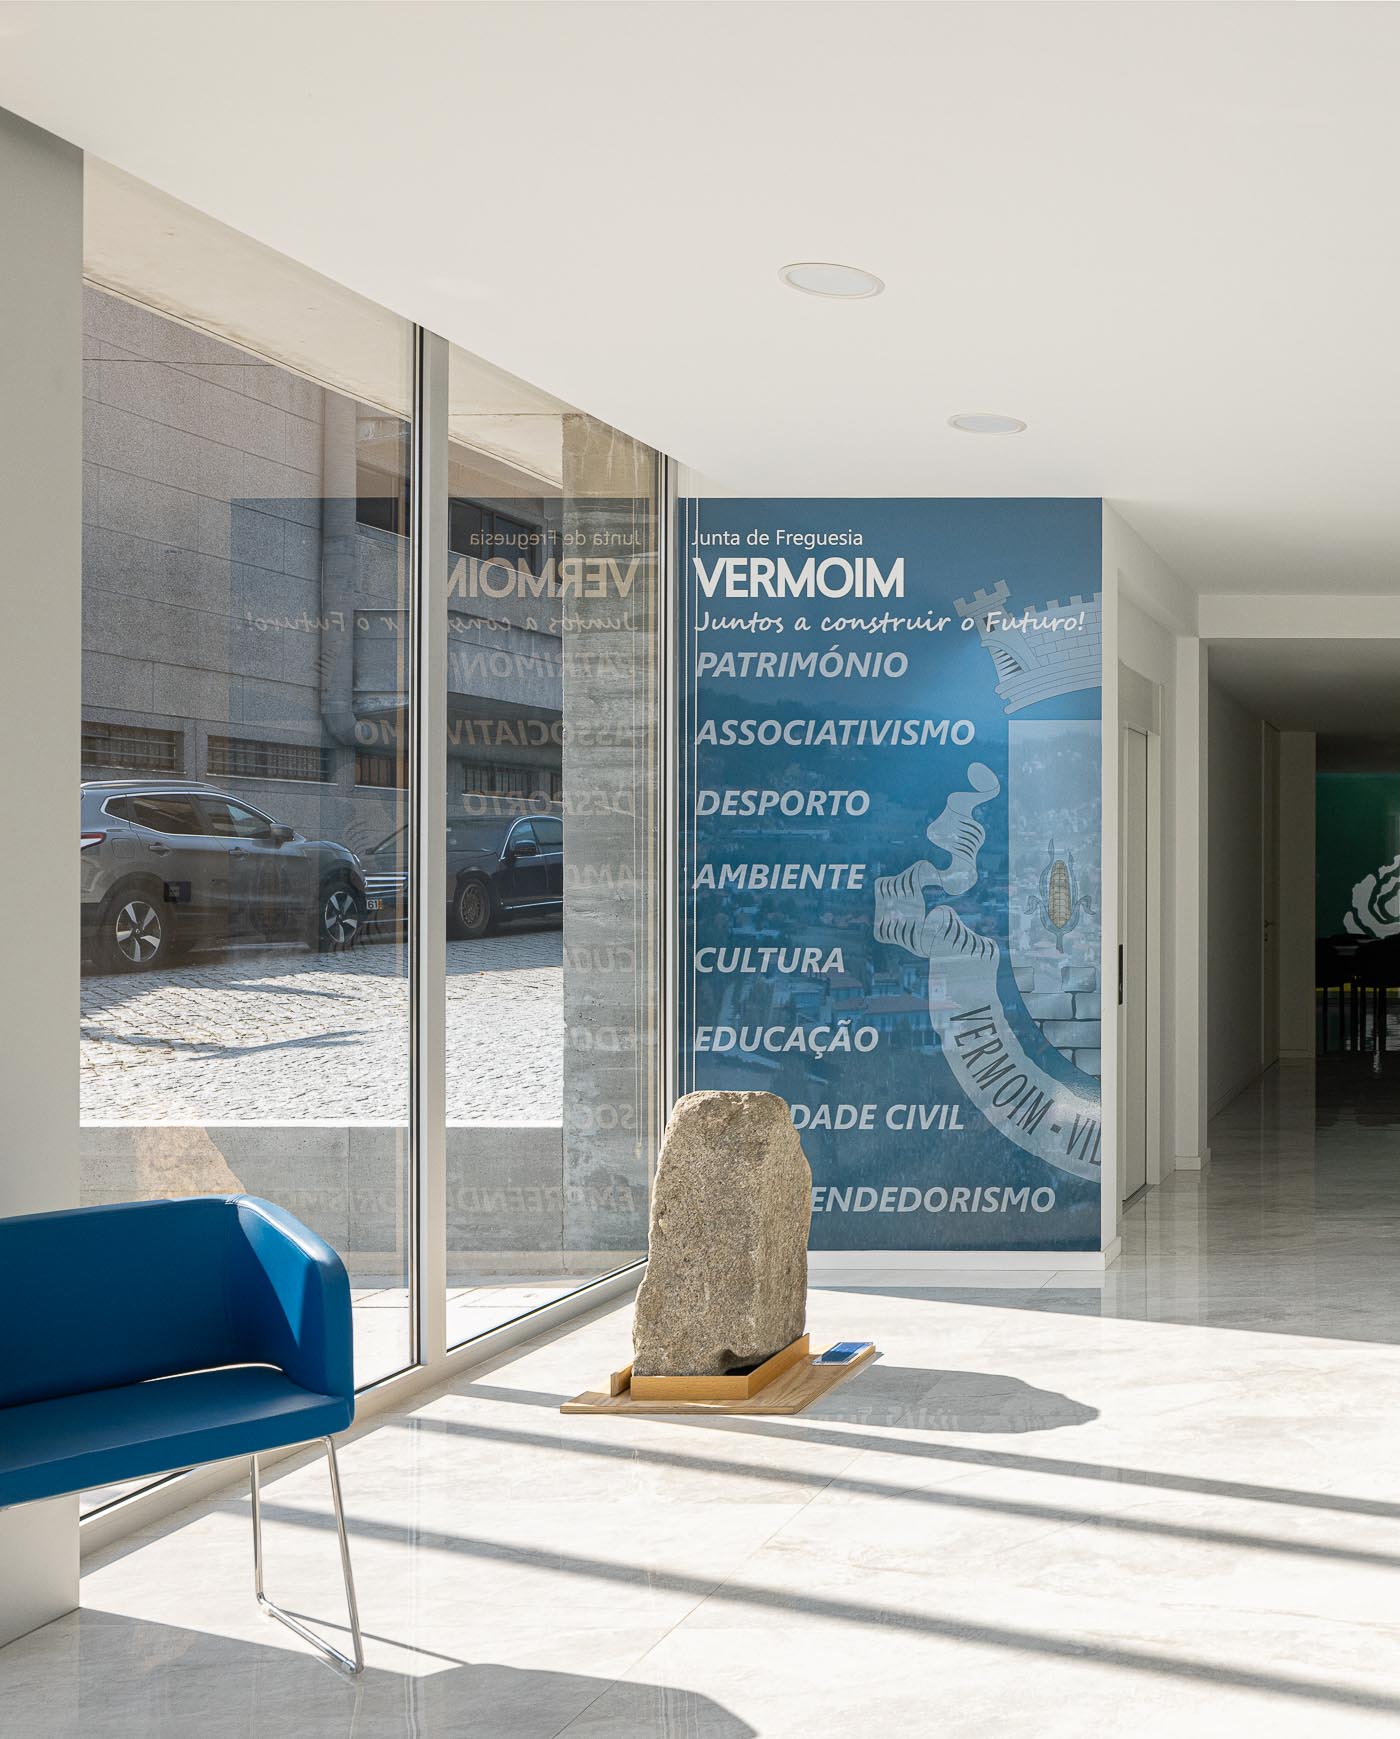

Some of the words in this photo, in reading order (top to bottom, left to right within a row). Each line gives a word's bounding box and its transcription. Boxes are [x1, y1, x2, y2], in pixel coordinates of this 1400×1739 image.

[691, 529, 740, 548] Junta
[746, 529, 770, 546] de
[775, 529, 864, 551] Freguesia
[692, 556, 905, 598] VERMOIM
[694, 610, 785, 635] Juntos
[793, 614, 812, 632] a
[820, 610, 951, 634] construir
[960, 614, 976, 632] o
[985, 609, 1086, 634] Futuro!
[696, 644, 908, 678] PATRIMÓNIO
[694, 719, 976, 746] ASSOCIATIVISMO
[695, 790, 870, 816] DESPORTO
[692, 863, 866, 890] AMBIENTE
[694, 947, 845, 973] CULTURA
[694, 1019, 879, 1059] EDUCAÇÃO
[950, 1004, 1055, 1136] VERMOIM
[885, 1104, 965, 1130] CIVIL
[811, 1186, 1056, 1212] ENDEDORISMO
